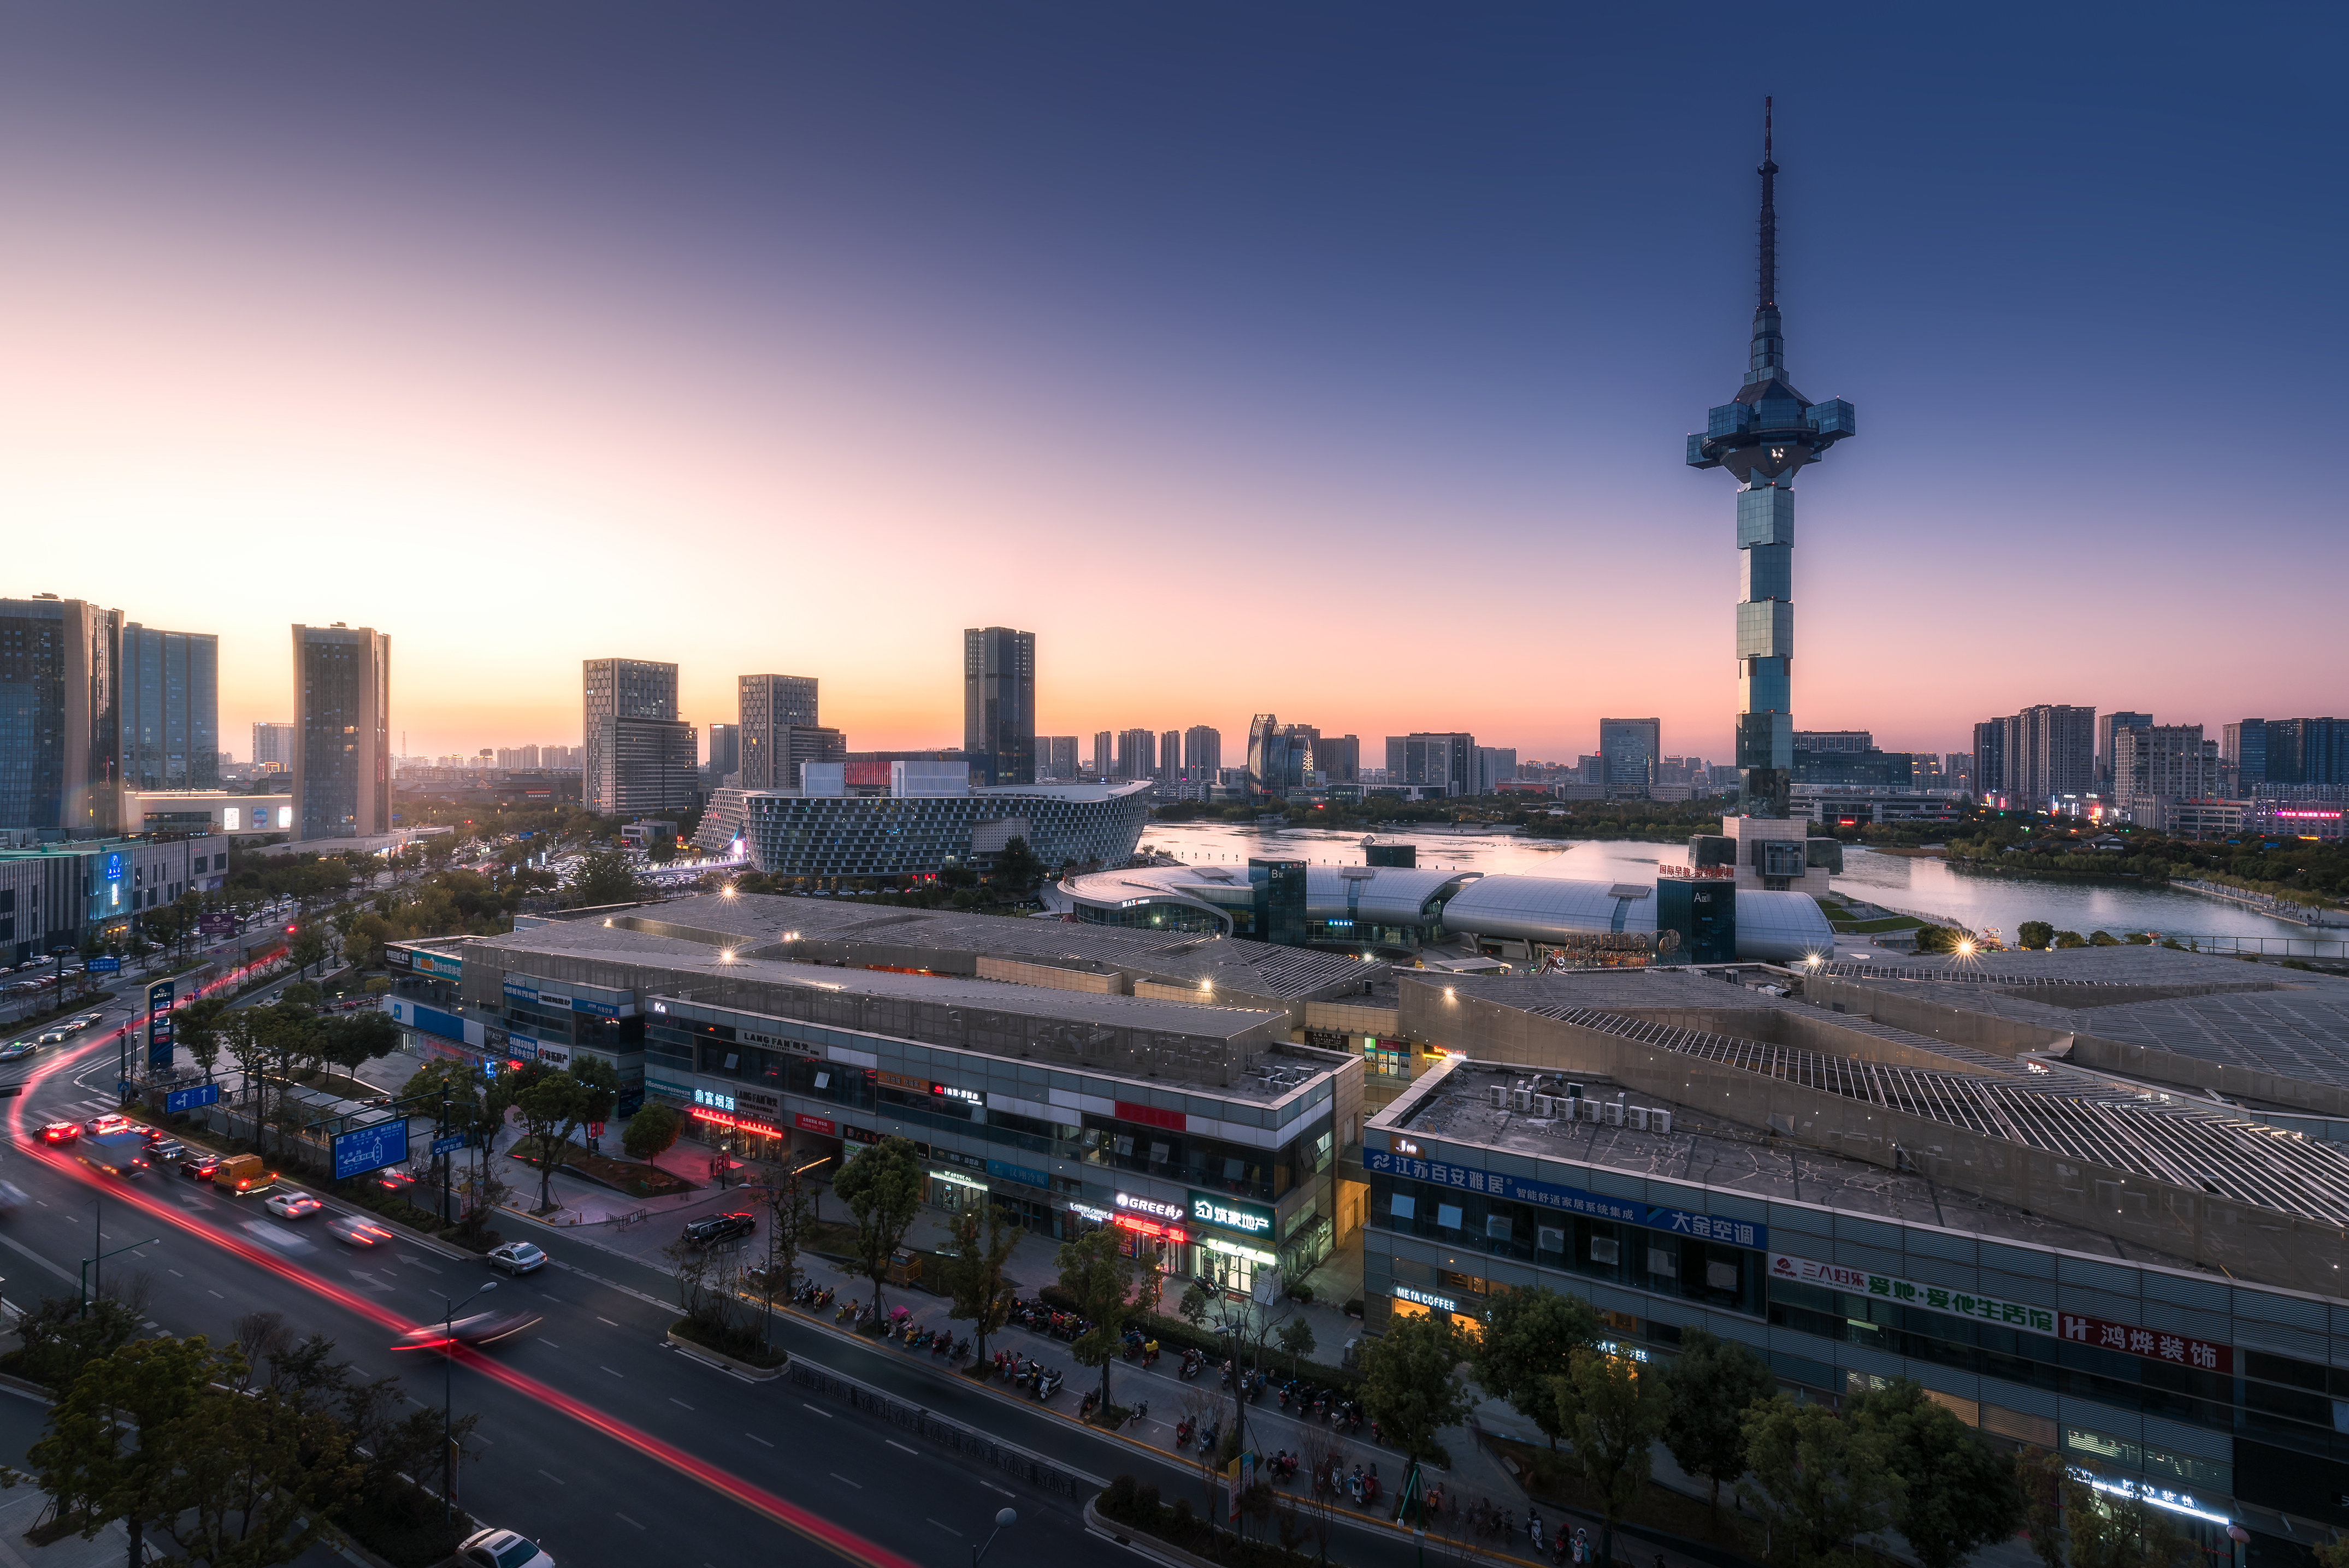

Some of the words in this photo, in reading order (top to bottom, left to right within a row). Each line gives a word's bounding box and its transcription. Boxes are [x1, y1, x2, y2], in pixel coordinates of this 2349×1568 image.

[1660, 865, 1691, 878] 国际早教
[1122, 900, 1136, 908] MAX
[1694, 892, 1707, 902] A区
[509, 1037, 535, 1051] SAMSUNG
[744, 1032, 770, 1044] LANG
[645, 1080, 668, 1091] Hisense
[695, 1088, 735, 1111] 鼎富烟酒
[735, 1089, 752, 1102] LANG
[381, 1122, 403, 1133] 解放南路
[352, 1131, 374, 1140] 聚龙路
[442, 1142, 462, 1152] 停车场
[1396, 1156, 1503, 1194] 江苏百安雅居
[1129, 1198, 1165, 1215] GREE
[1516, 1187, 1634, 1221] 智能舒适家居系统集成
[1214, 1206, 1269, 1230] 筑家地产
[1672, 1212, 1754, 1245] 大金空调
[1803, 1262, 1864, 1287] 三八妇乐
[1397, 1287, 1420, 1303] META
[1423, 1294, 1455, 1312] COFFEE
[1869, 1275, 2052, 1332] 爱她·爱他生活馆
[2100, 1324, 2216, 1368] 鸿烨装饰
